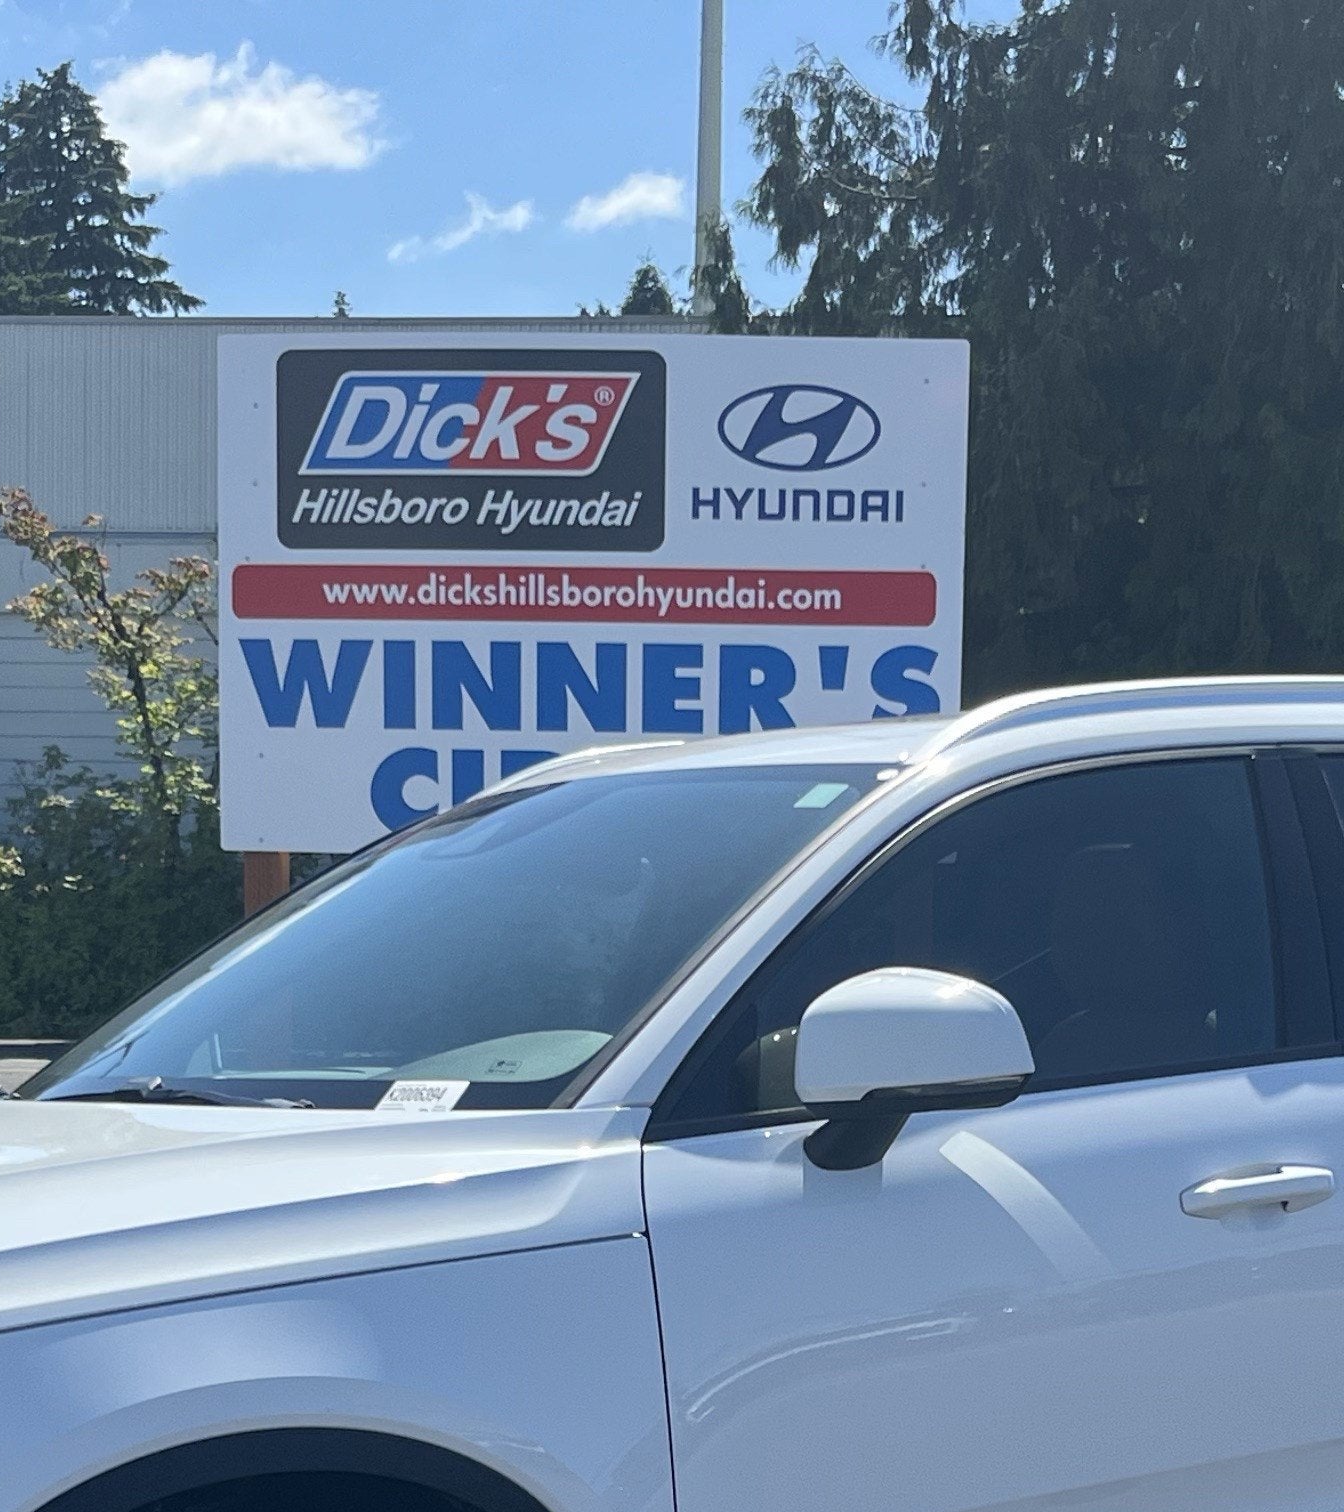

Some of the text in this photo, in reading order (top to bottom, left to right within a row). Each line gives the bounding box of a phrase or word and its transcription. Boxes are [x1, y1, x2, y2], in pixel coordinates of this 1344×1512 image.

[325, 383, 598, 463] Dick's
[292, 488, 643, 535] Hillsboro Hyundai
[691, 487, 904, 523] HYUNDAI
[322, 571, 842, 617] www.dickshillsborohyundai.com
[238, 639, 940, 735] WINNER'S
[370, 747, 561, 832] CI
